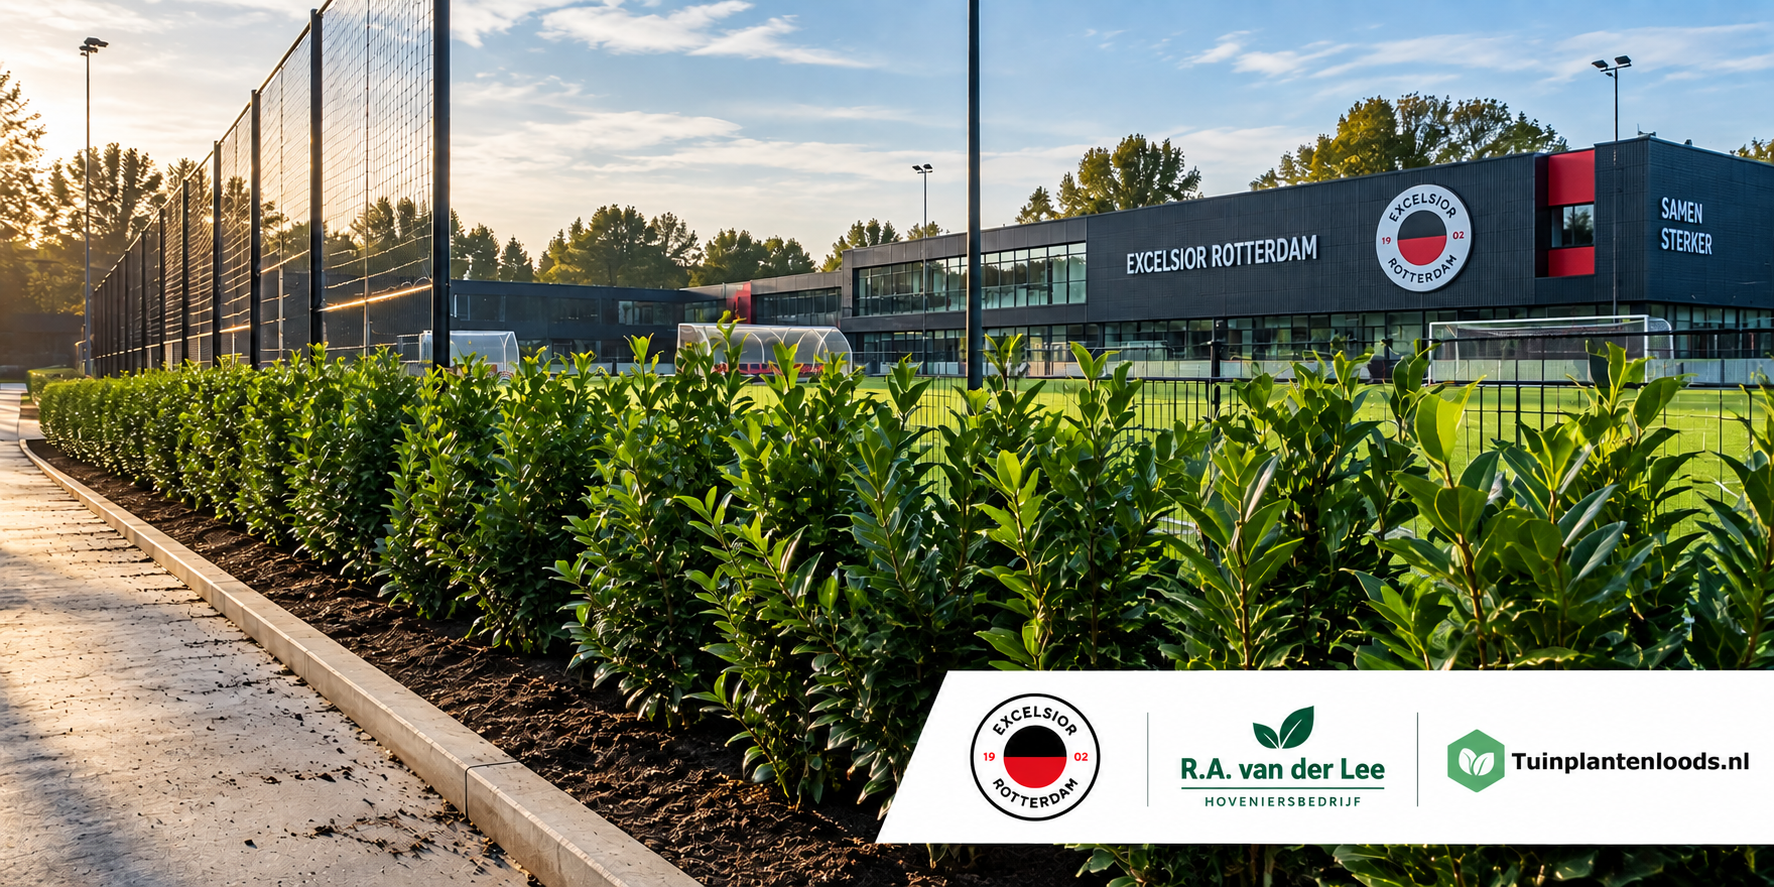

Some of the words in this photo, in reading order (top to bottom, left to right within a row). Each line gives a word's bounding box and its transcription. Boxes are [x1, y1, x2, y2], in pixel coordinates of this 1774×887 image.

[1388, 192, 1457, 223] EXCELSIOR
[1661, 196, 1703, 224] SAMEN
[1381, 236, 1391, 245] 19
[1452, 230, 1465, 240] 02
[1661, 227, 1713, 255] STERKER
[1126, 246, 1207, 275] EXCELSIOR
[1211, 234, 1318, 268] ROTTERDAM
[1388, 254, 1458, 284] ROTTERDAM
